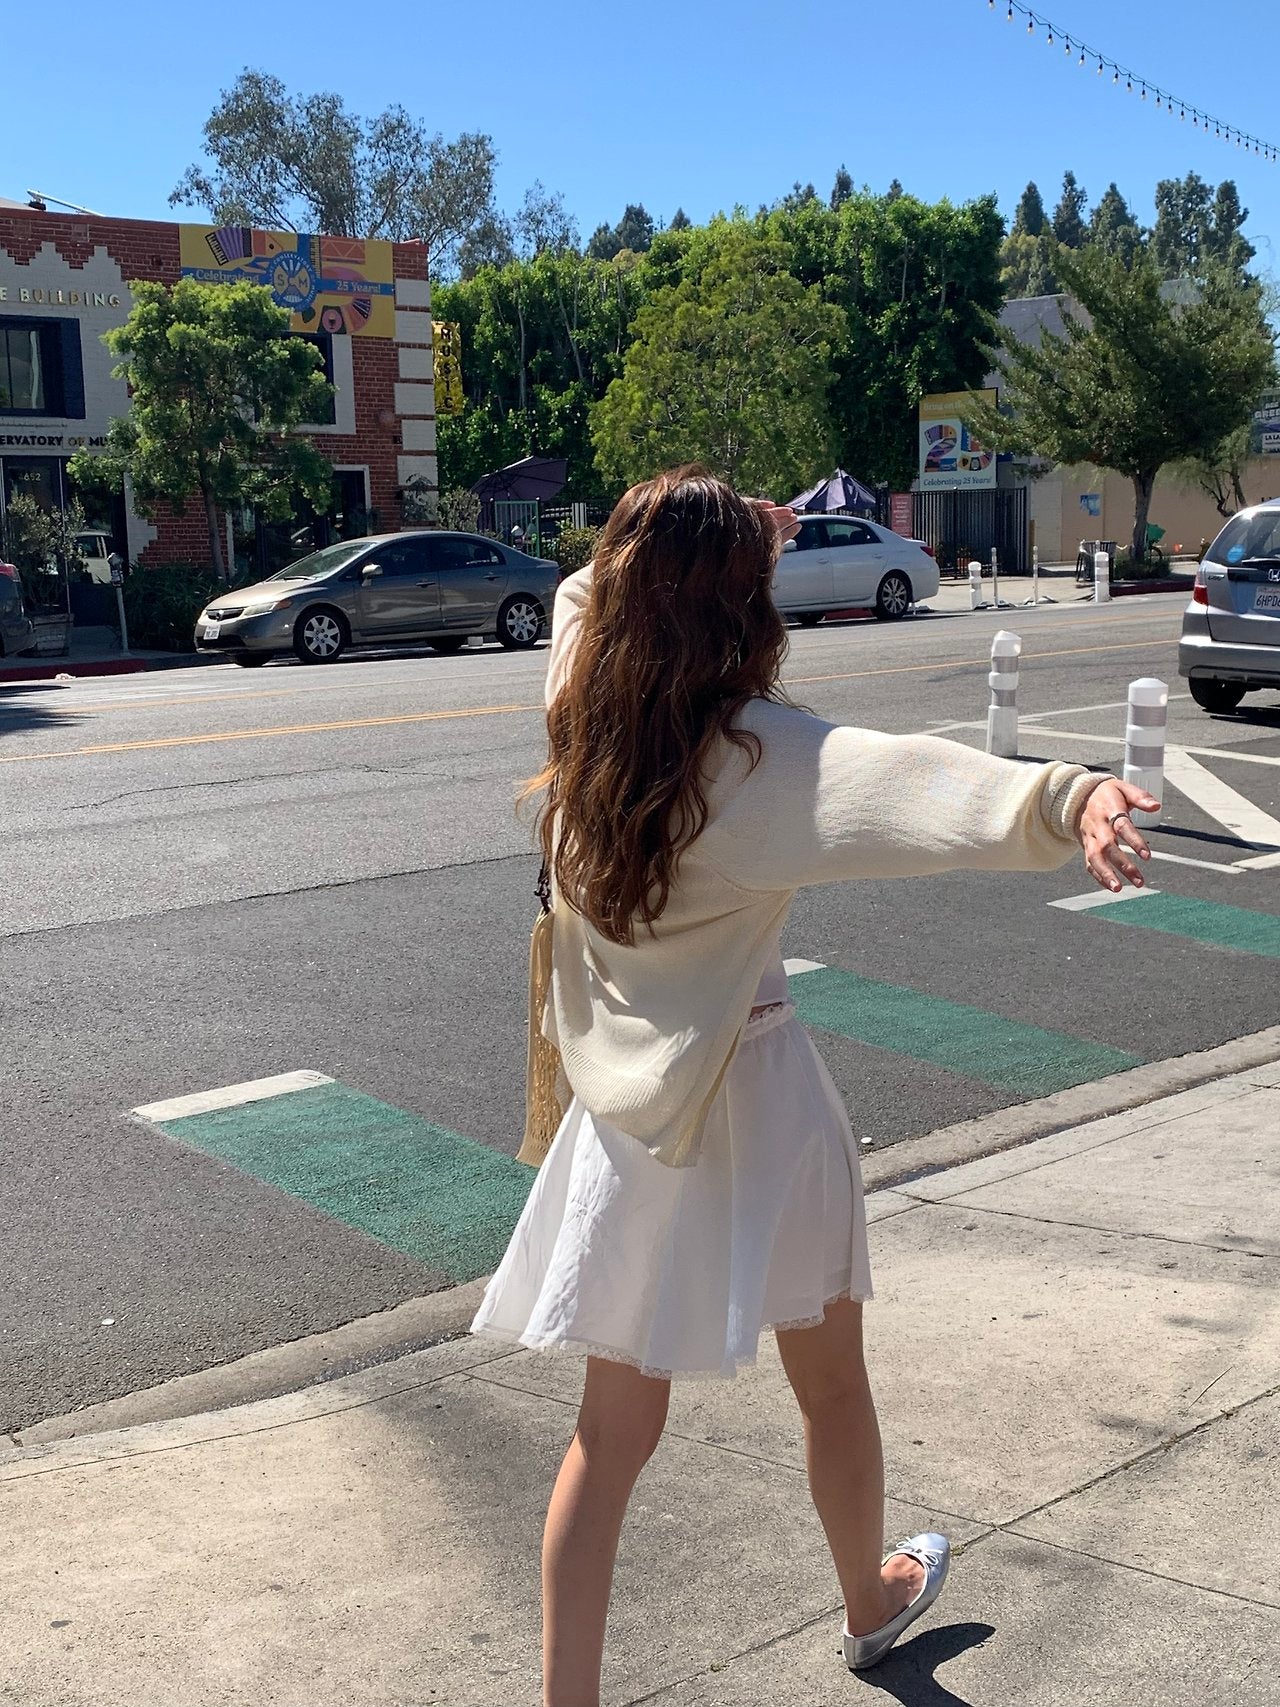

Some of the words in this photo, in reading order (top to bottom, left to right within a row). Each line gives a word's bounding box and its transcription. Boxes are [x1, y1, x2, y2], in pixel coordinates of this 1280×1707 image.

[336, 280, 349, 292] 25
[351, 281, 381, 294] Years!
[19, 287, 121, 308] BUILDING
[440, 327, 453, 409] MUSIC
[67, 436, 86, 447] OF
[923, 477, 962, 487] Celebrating
